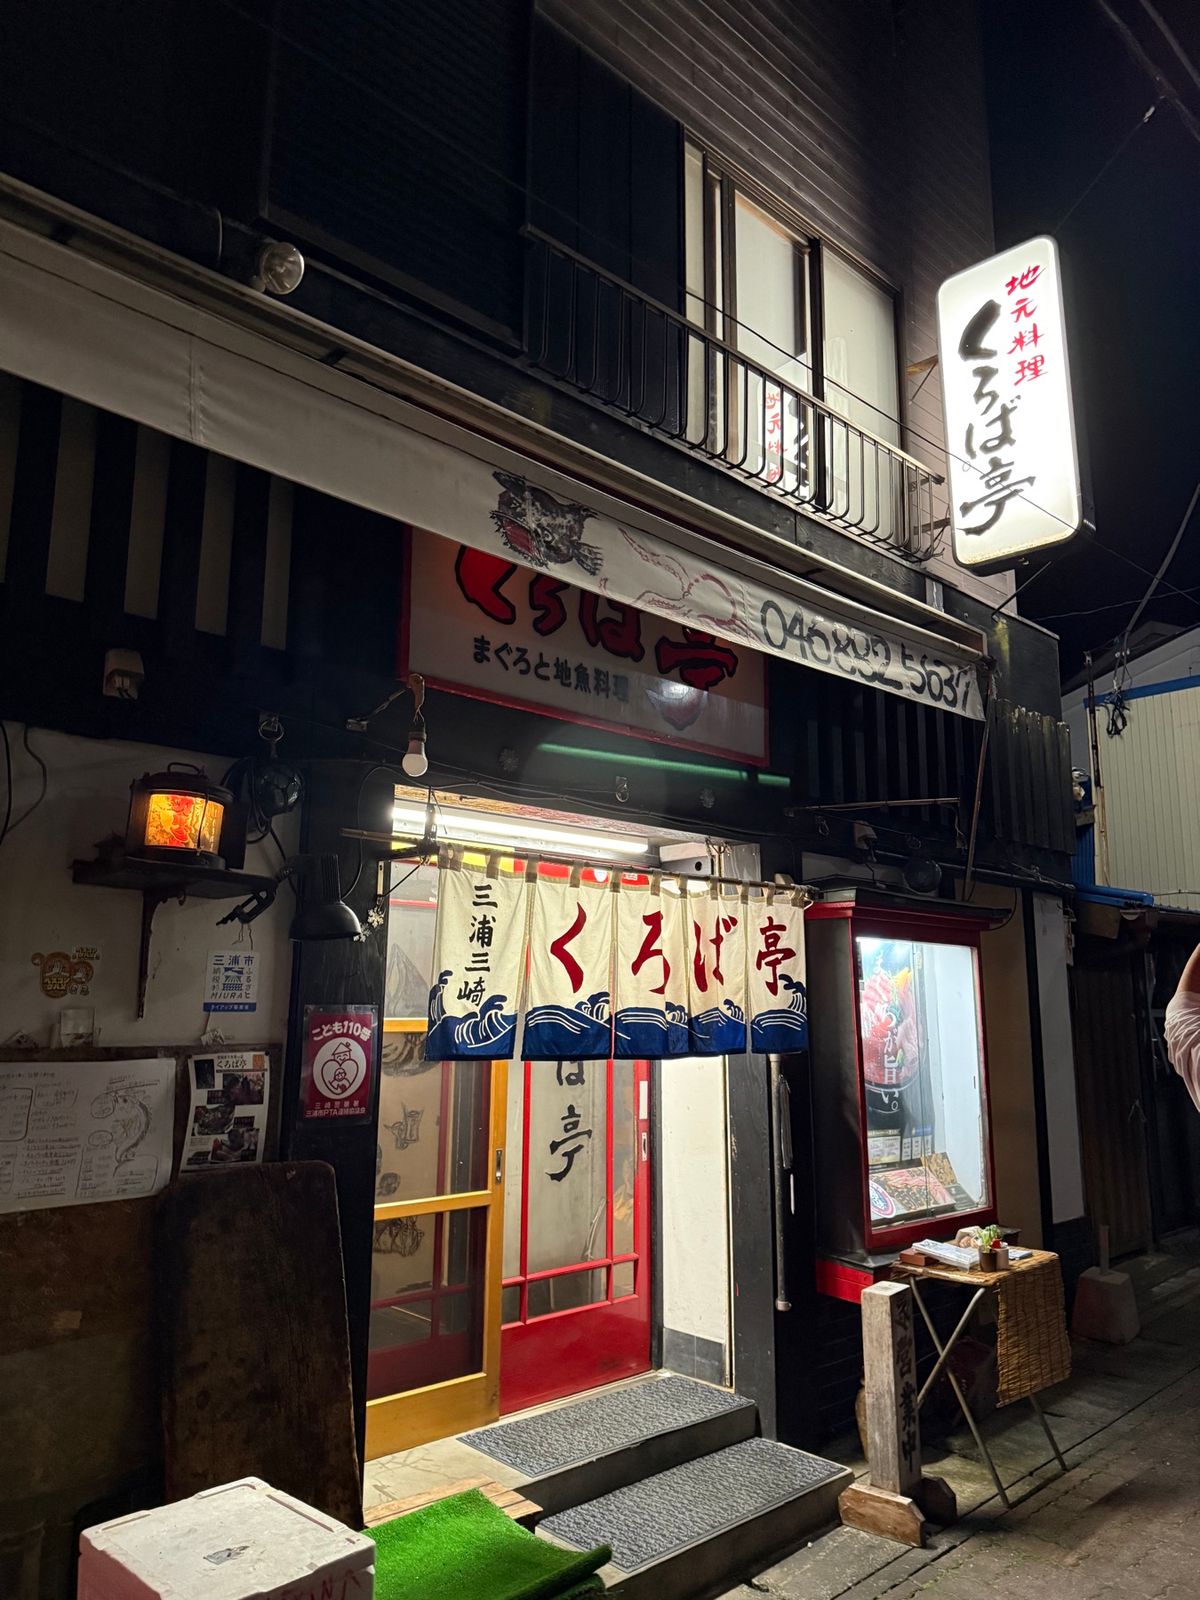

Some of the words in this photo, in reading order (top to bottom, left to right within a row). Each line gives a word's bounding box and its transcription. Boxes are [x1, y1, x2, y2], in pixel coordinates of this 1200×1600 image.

[1005, 264, 1048, 387] 地元料理
[958, 299, 1036, 536] くろば亭
[473, 635, 630, 703] まぐろと地魚料理
[213, 954, 255, 966] 三浦市
[457, 883, 499, 1008] 三浦三崎
[550, 901, 797, 997] くろば亭
[312, 1021, 371, 1042] こども110番
